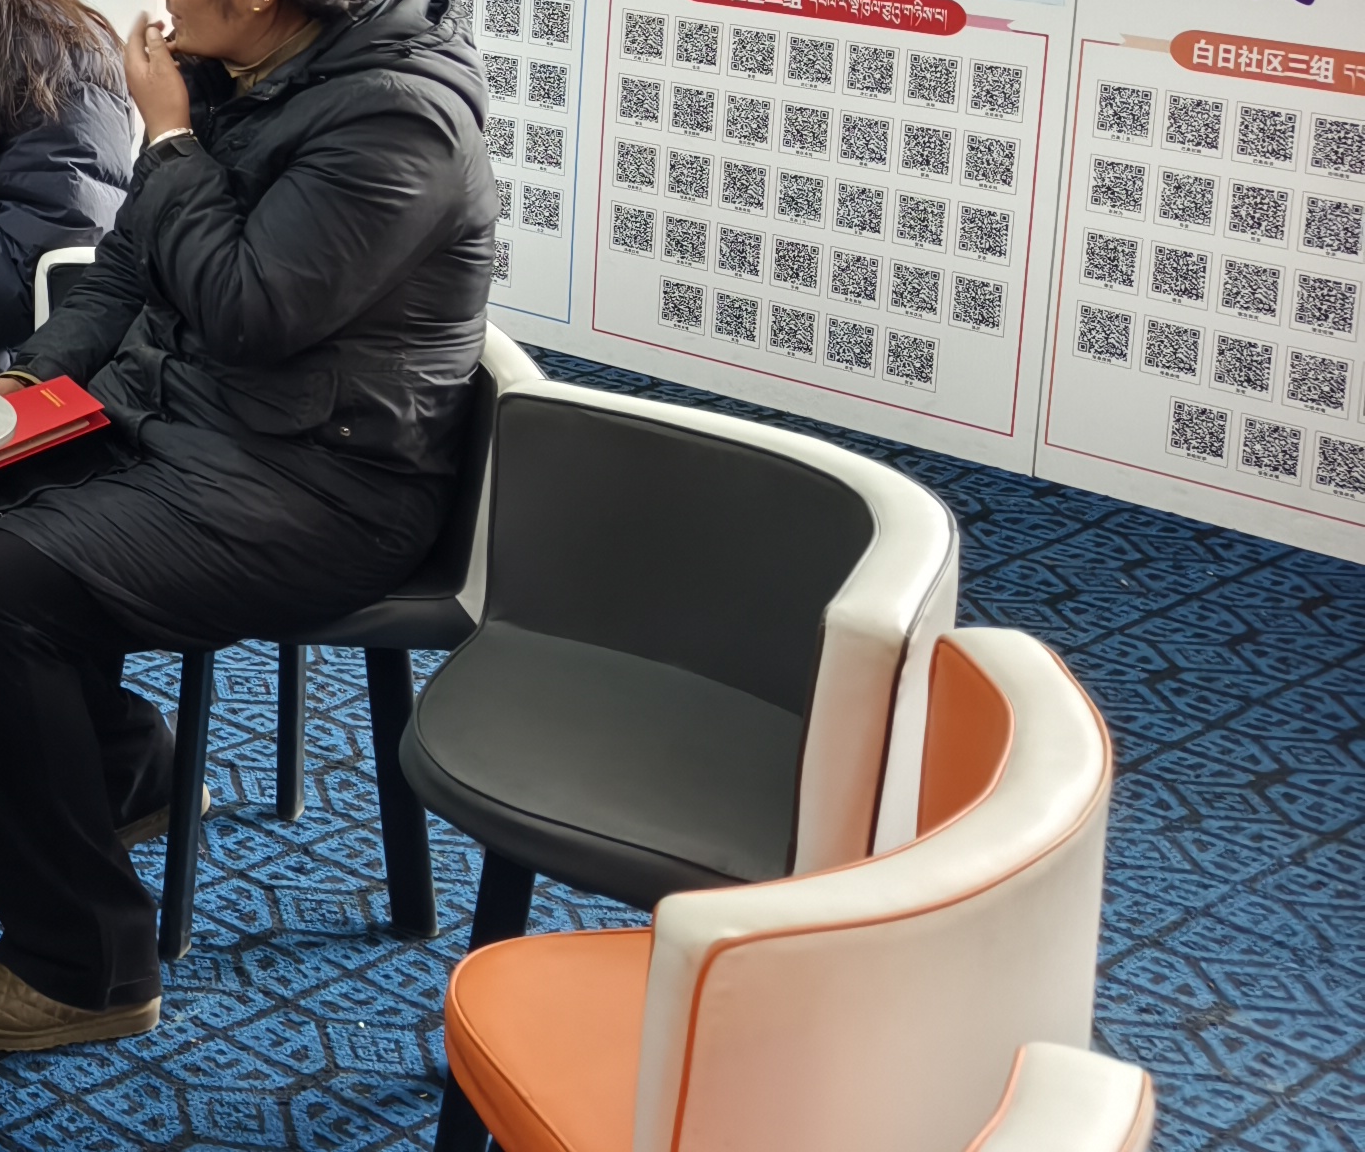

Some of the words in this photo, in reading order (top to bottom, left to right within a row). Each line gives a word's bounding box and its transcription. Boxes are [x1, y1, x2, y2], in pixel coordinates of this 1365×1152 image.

[1192, 39, 1335, 84] 白日社区三组
